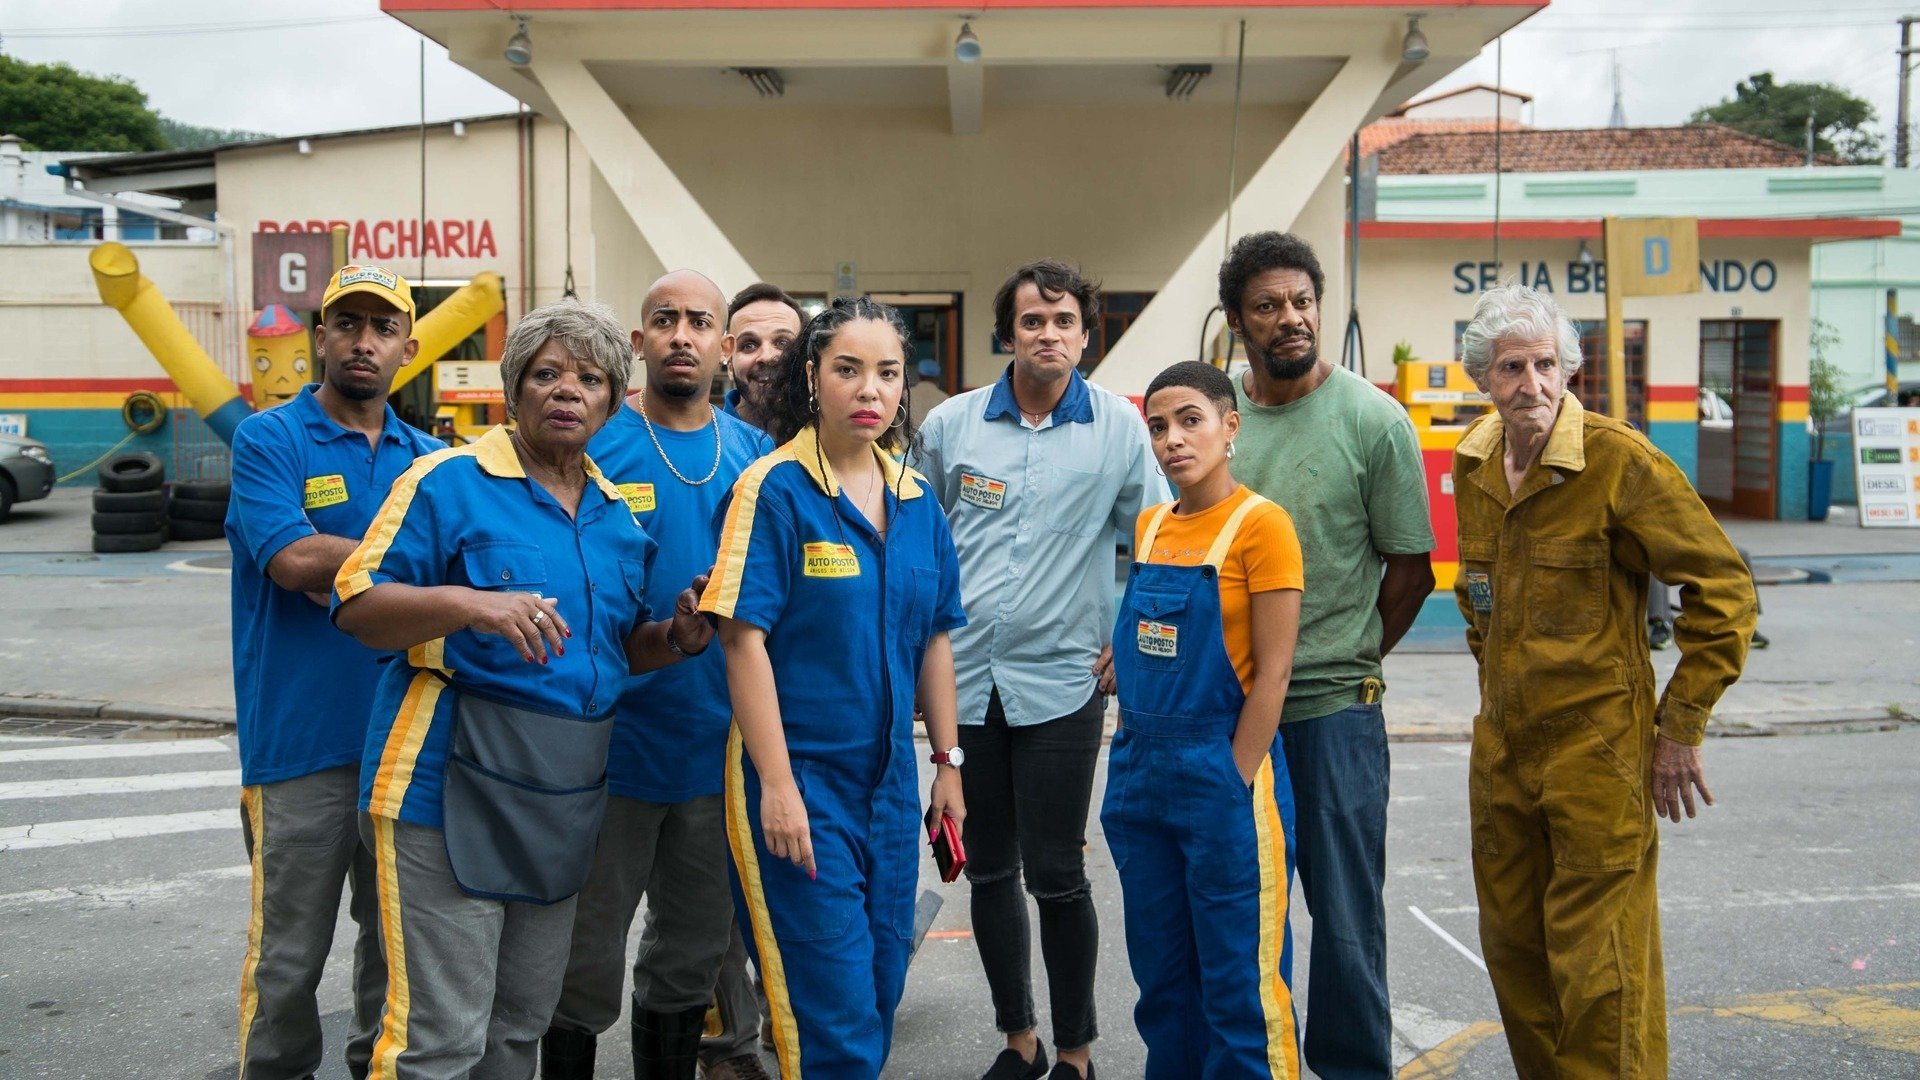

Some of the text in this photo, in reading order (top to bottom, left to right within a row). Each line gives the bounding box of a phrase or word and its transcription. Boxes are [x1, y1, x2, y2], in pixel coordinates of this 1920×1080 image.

[258, 219, 497, 260] ACHARIA
[1643, 237, 1671, 276] D
[279, 252, 307, 294] G
[319, 487, 344, 498] POSTO
[627, 495, 652, 504] POSTO
[962, 485, 1001, 501] AUTO POSTO
[808, 557, 855, 567] AUTO POSTO
[1139, 634, 1174, 648] AUTO POSTO
